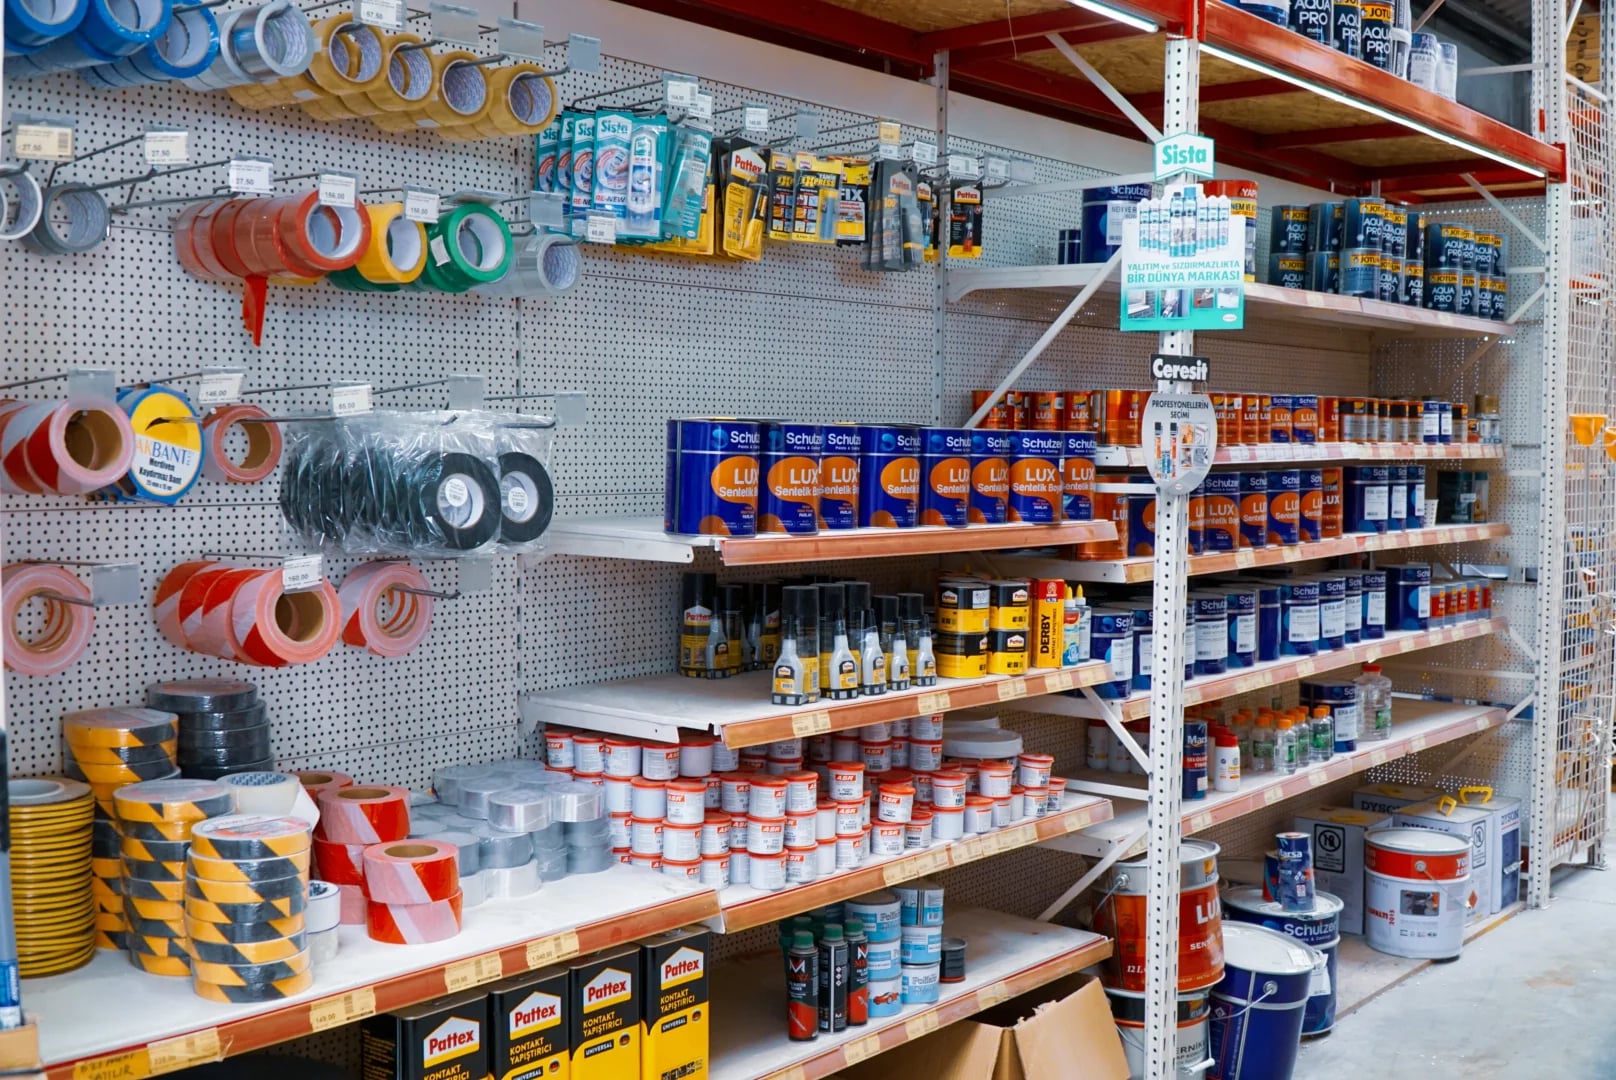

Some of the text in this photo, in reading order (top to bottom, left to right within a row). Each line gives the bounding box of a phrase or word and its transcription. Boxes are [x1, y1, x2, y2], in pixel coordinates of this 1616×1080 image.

[1294, 0, 1331, 11] AQUA
[1299, 12, 1328, 25] PRO
[1338, 13, 1360, 27] AQU
[1370, 8, 1390, 19] JOTU
[1366, 40, 1391, 54] PRO
[600, 120, 628, 134] Sista
[1162, 144, 1207, 166] Sista
[735, 154, 762, 173] Pattex
[1128, 262, 1160, 271] YALITIM
[1127, 270, 1240, 284] BİR DÜNYA MARKASI
[1431, 286, 1455, 295] AQUA
[1433, 294, 1452, 302] PRO
[1152, 358, 1208, 380] Ceresit
[1152, 399, 1209, 409] PROFESYONELLERİN
[789, 468, 818, 485] LUX
[831, 468, 858, 484] LUX
[1025, 468, 1056, 482] LUX
[1071, 468, 1095, 481] LUX
[775, 486, 812, 497] Sentetik
[1013, 482, 1047, 492] Sentetik
[1209, 503, 1234, 516] LUX
[1252, 502, 1268, 513] LU
[1284, 500, 1300, 512] LU
[1040, 614, 1051, 654] DERBY
[882, 796, 898, 804] ASR
[664, 959, 700, 980] Pattex
[588, 980, 627, 1002] Pattex
[660, 988, 689, 1006] KONTAKT
[660, 994, 695, 1014] YAPIŞTIRICI
[514, 1004, 556, 1028] Pattex
[582, 1011, 615, 1029] KONTAKT
[583, 1018, 623, 1038] YAPIŞTIRICI
[429, 1029, 475, 1056] Pattex
[509, 1036, 544, 1056] KONTAKT
[585, 1042, 612, 1056] UNIVERSAL
[510, 1043, 552, 1065] YAPIŞTIRICI
